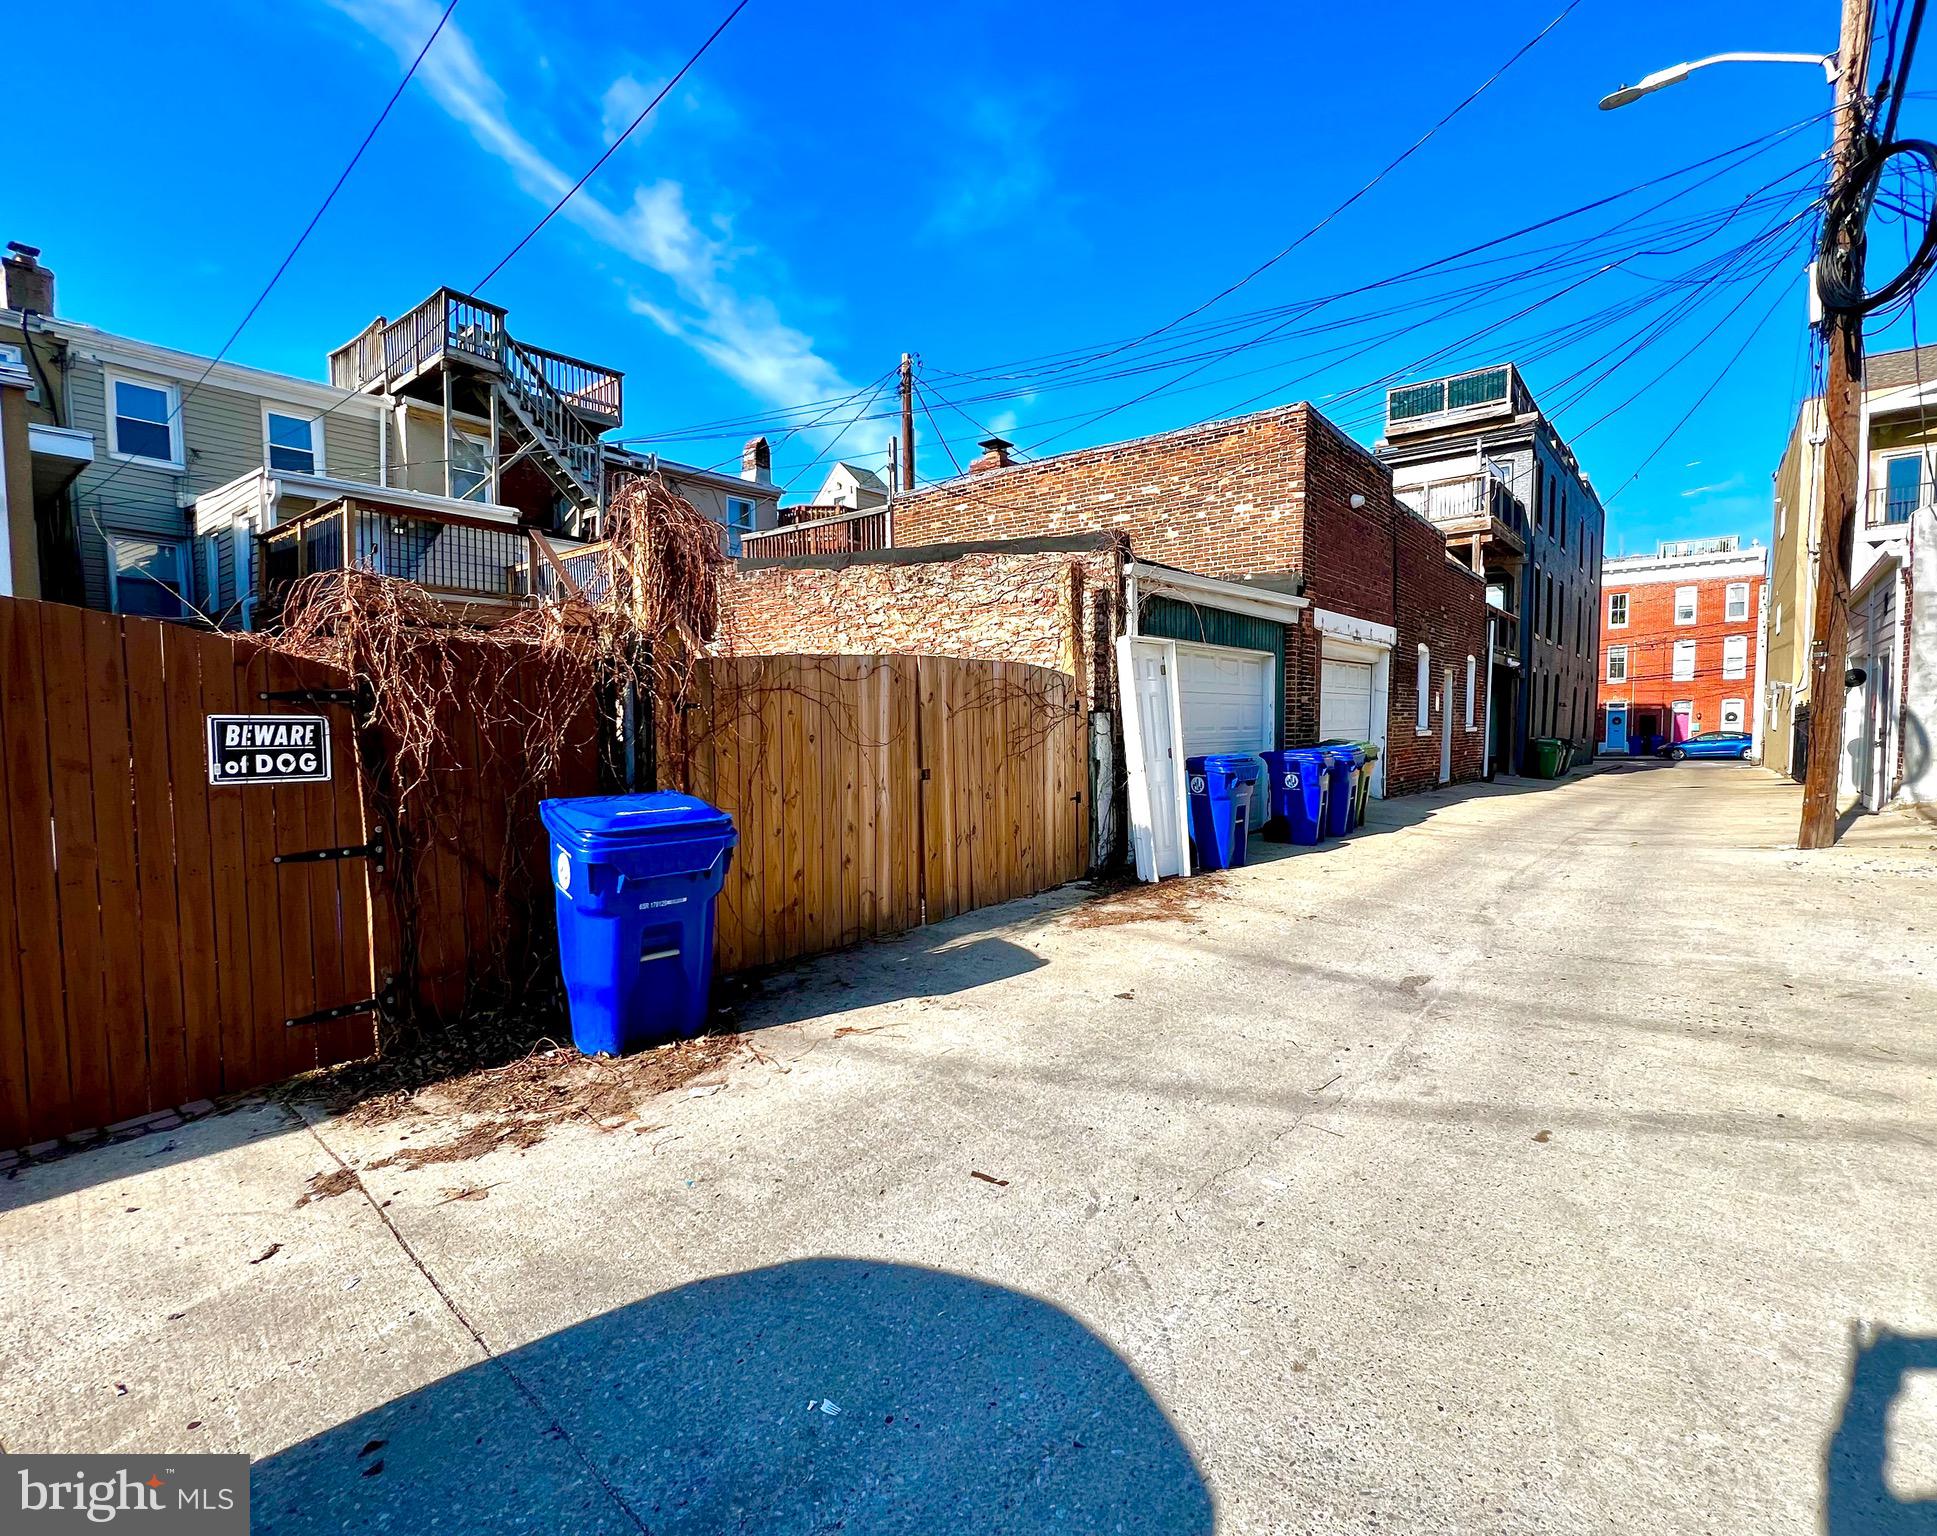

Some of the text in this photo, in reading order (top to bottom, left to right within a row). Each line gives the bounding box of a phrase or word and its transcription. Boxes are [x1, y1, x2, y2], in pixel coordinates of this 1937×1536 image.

[225, 725, 315, 746] BEWARE
[225, 753, 317, 774] of DOG
